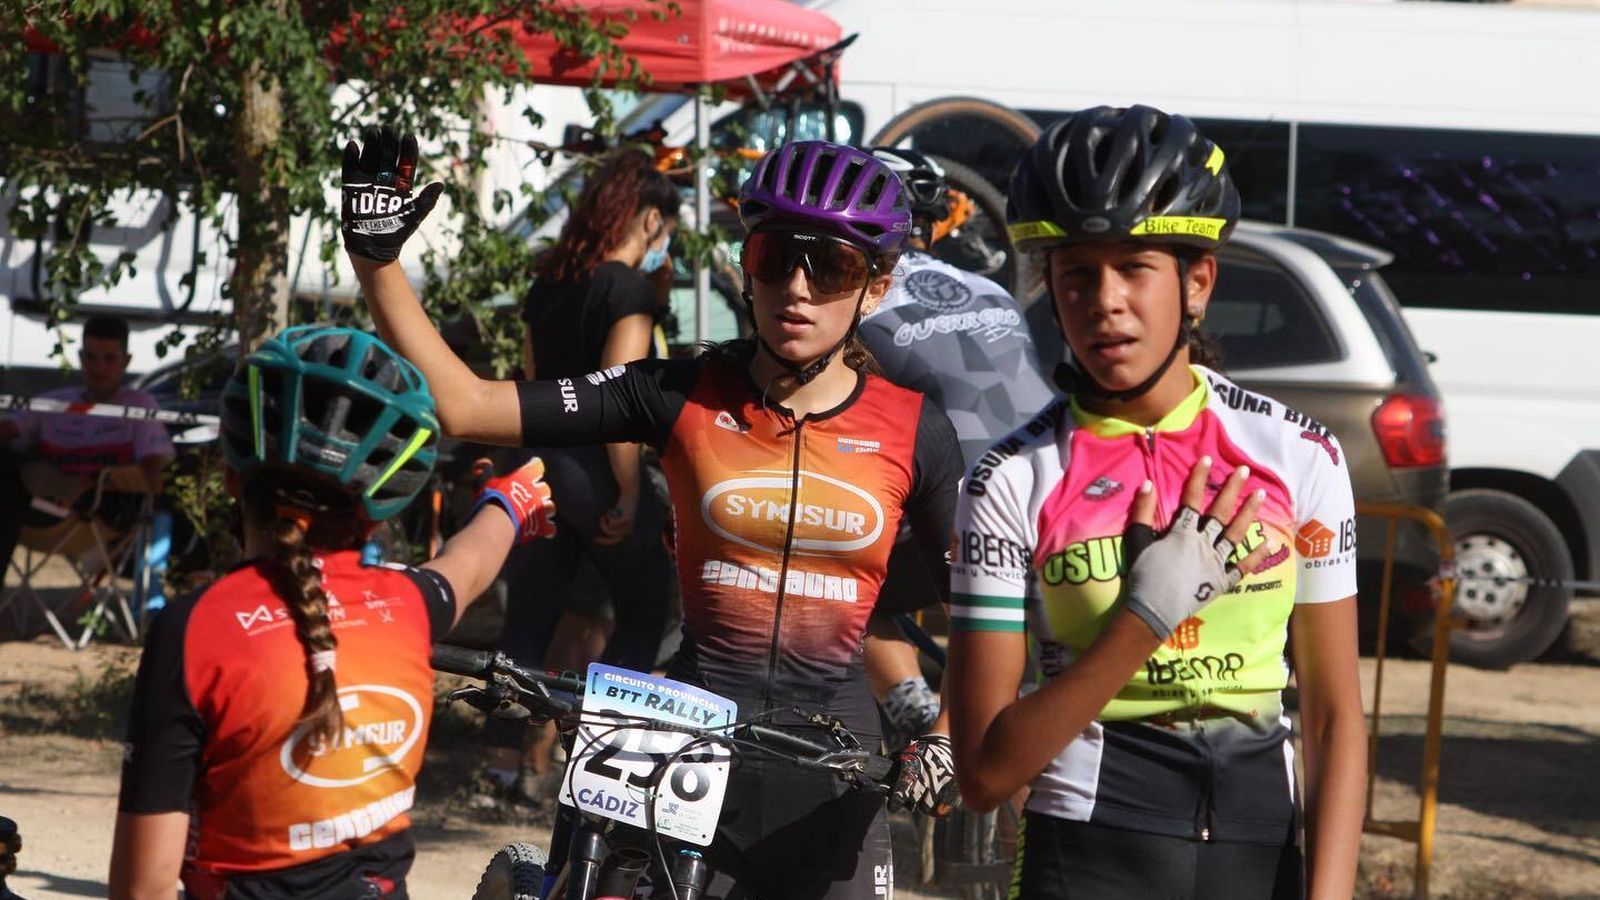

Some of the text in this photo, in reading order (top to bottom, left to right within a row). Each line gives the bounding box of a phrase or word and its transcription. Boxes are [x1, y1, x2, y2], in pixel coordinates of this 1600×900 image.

[1145, 220, 1217, 235] Bike Team
[725, 494, 865, 535] SYMISUR
[604, 672, 721, 713] CIRCUITO PROVINCIAL
[606, 686, 719, 726] BTT RALLY
[578, 788, 640, 819] CÁDIZ
